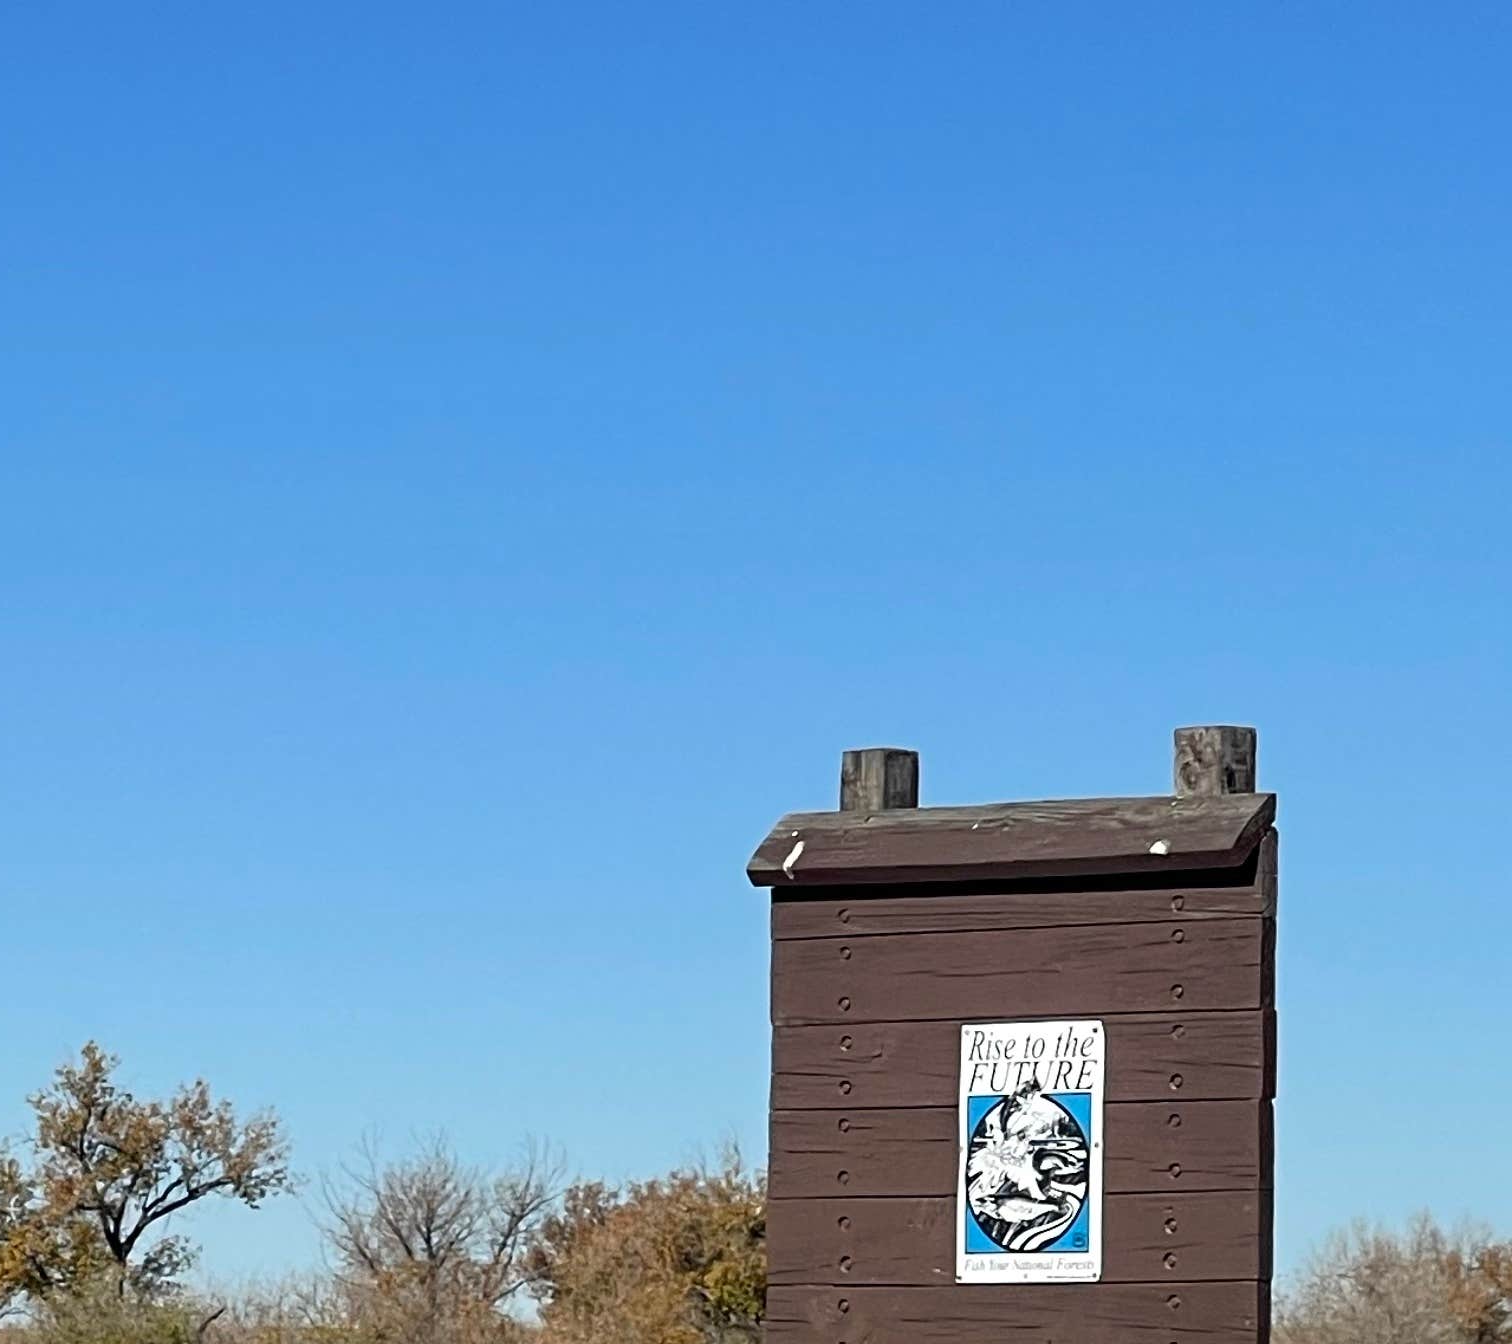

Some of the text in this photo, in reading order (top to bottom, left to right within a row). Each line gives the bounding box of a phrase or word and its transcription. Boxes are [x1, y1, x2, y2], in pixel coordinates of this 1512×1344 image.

[968, 1027, 1094, 1061] Rise to the
[968, 1059, 1098, 1093] FUTURE
